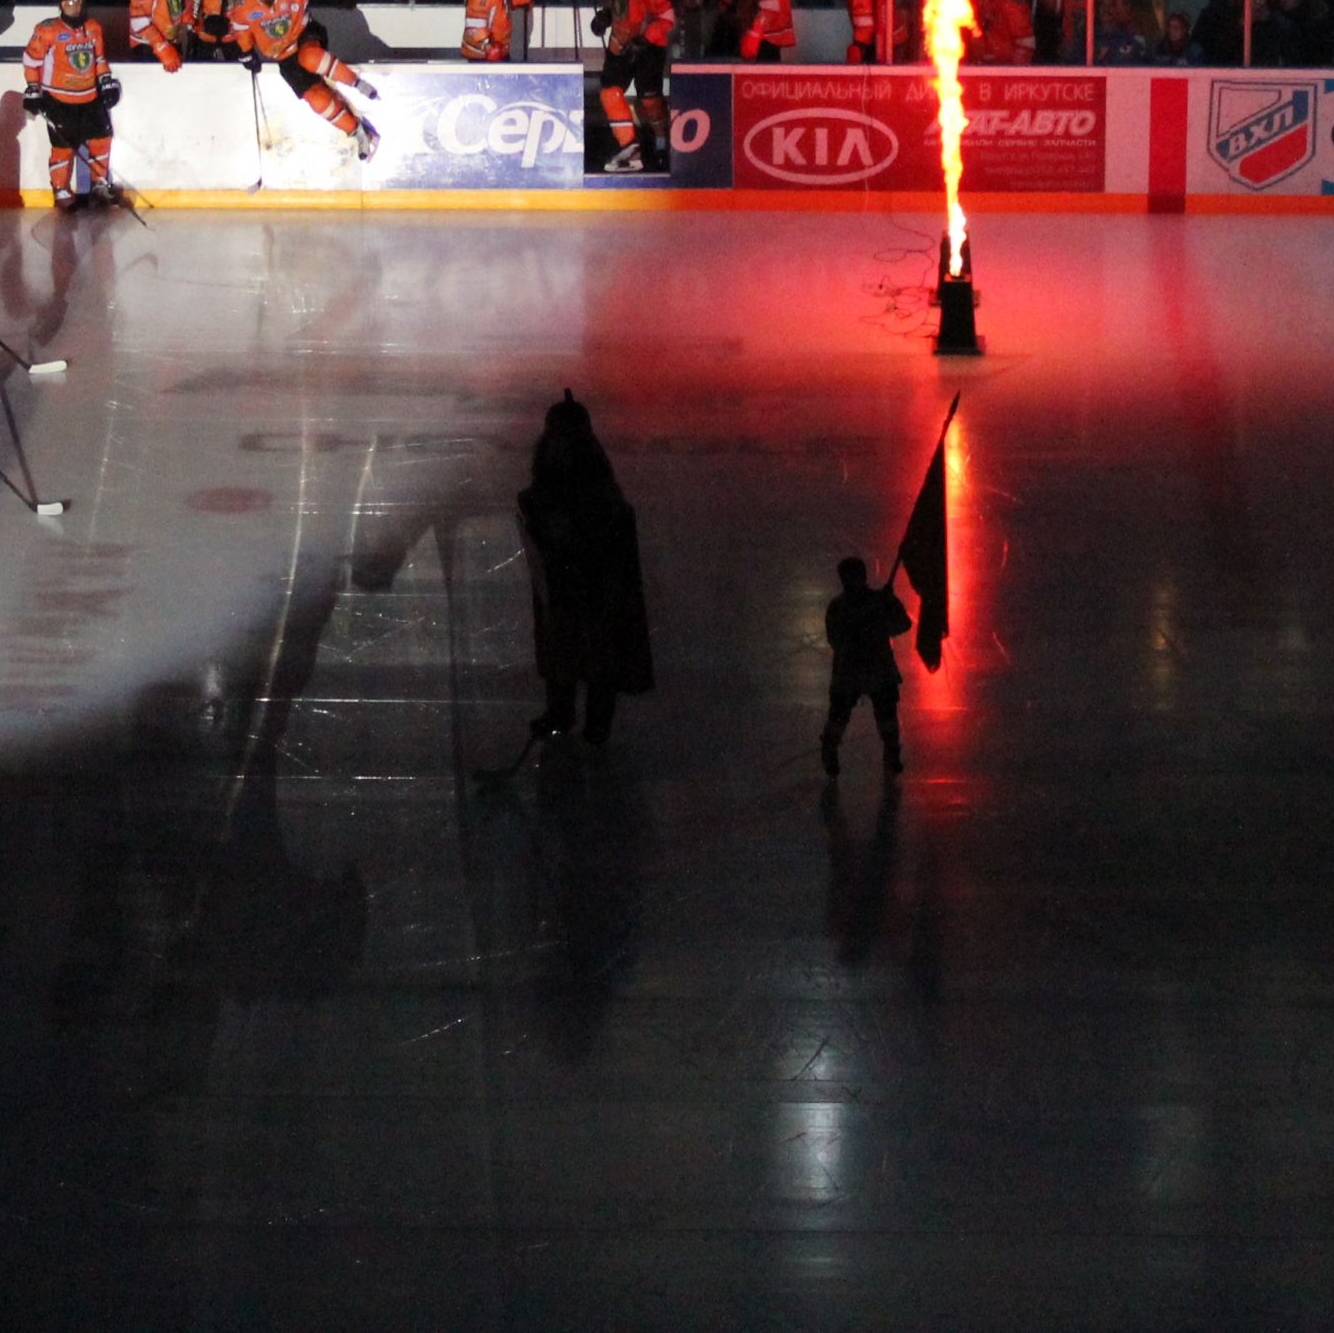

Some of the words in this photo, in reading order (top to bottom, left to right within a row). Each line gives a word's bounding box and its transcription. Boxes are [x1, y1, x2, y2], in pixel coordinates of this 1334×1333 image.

[742, 81, 892, 101] ОФИЦИАЛЬНЫЙ
[980, 83, 991, 101] В
[1004, 83, 1094, 102] ИРКУТСКЕ
[1228, 101, 1294, 159] ВХЛ
[772, 127, 874, 166] KIA
